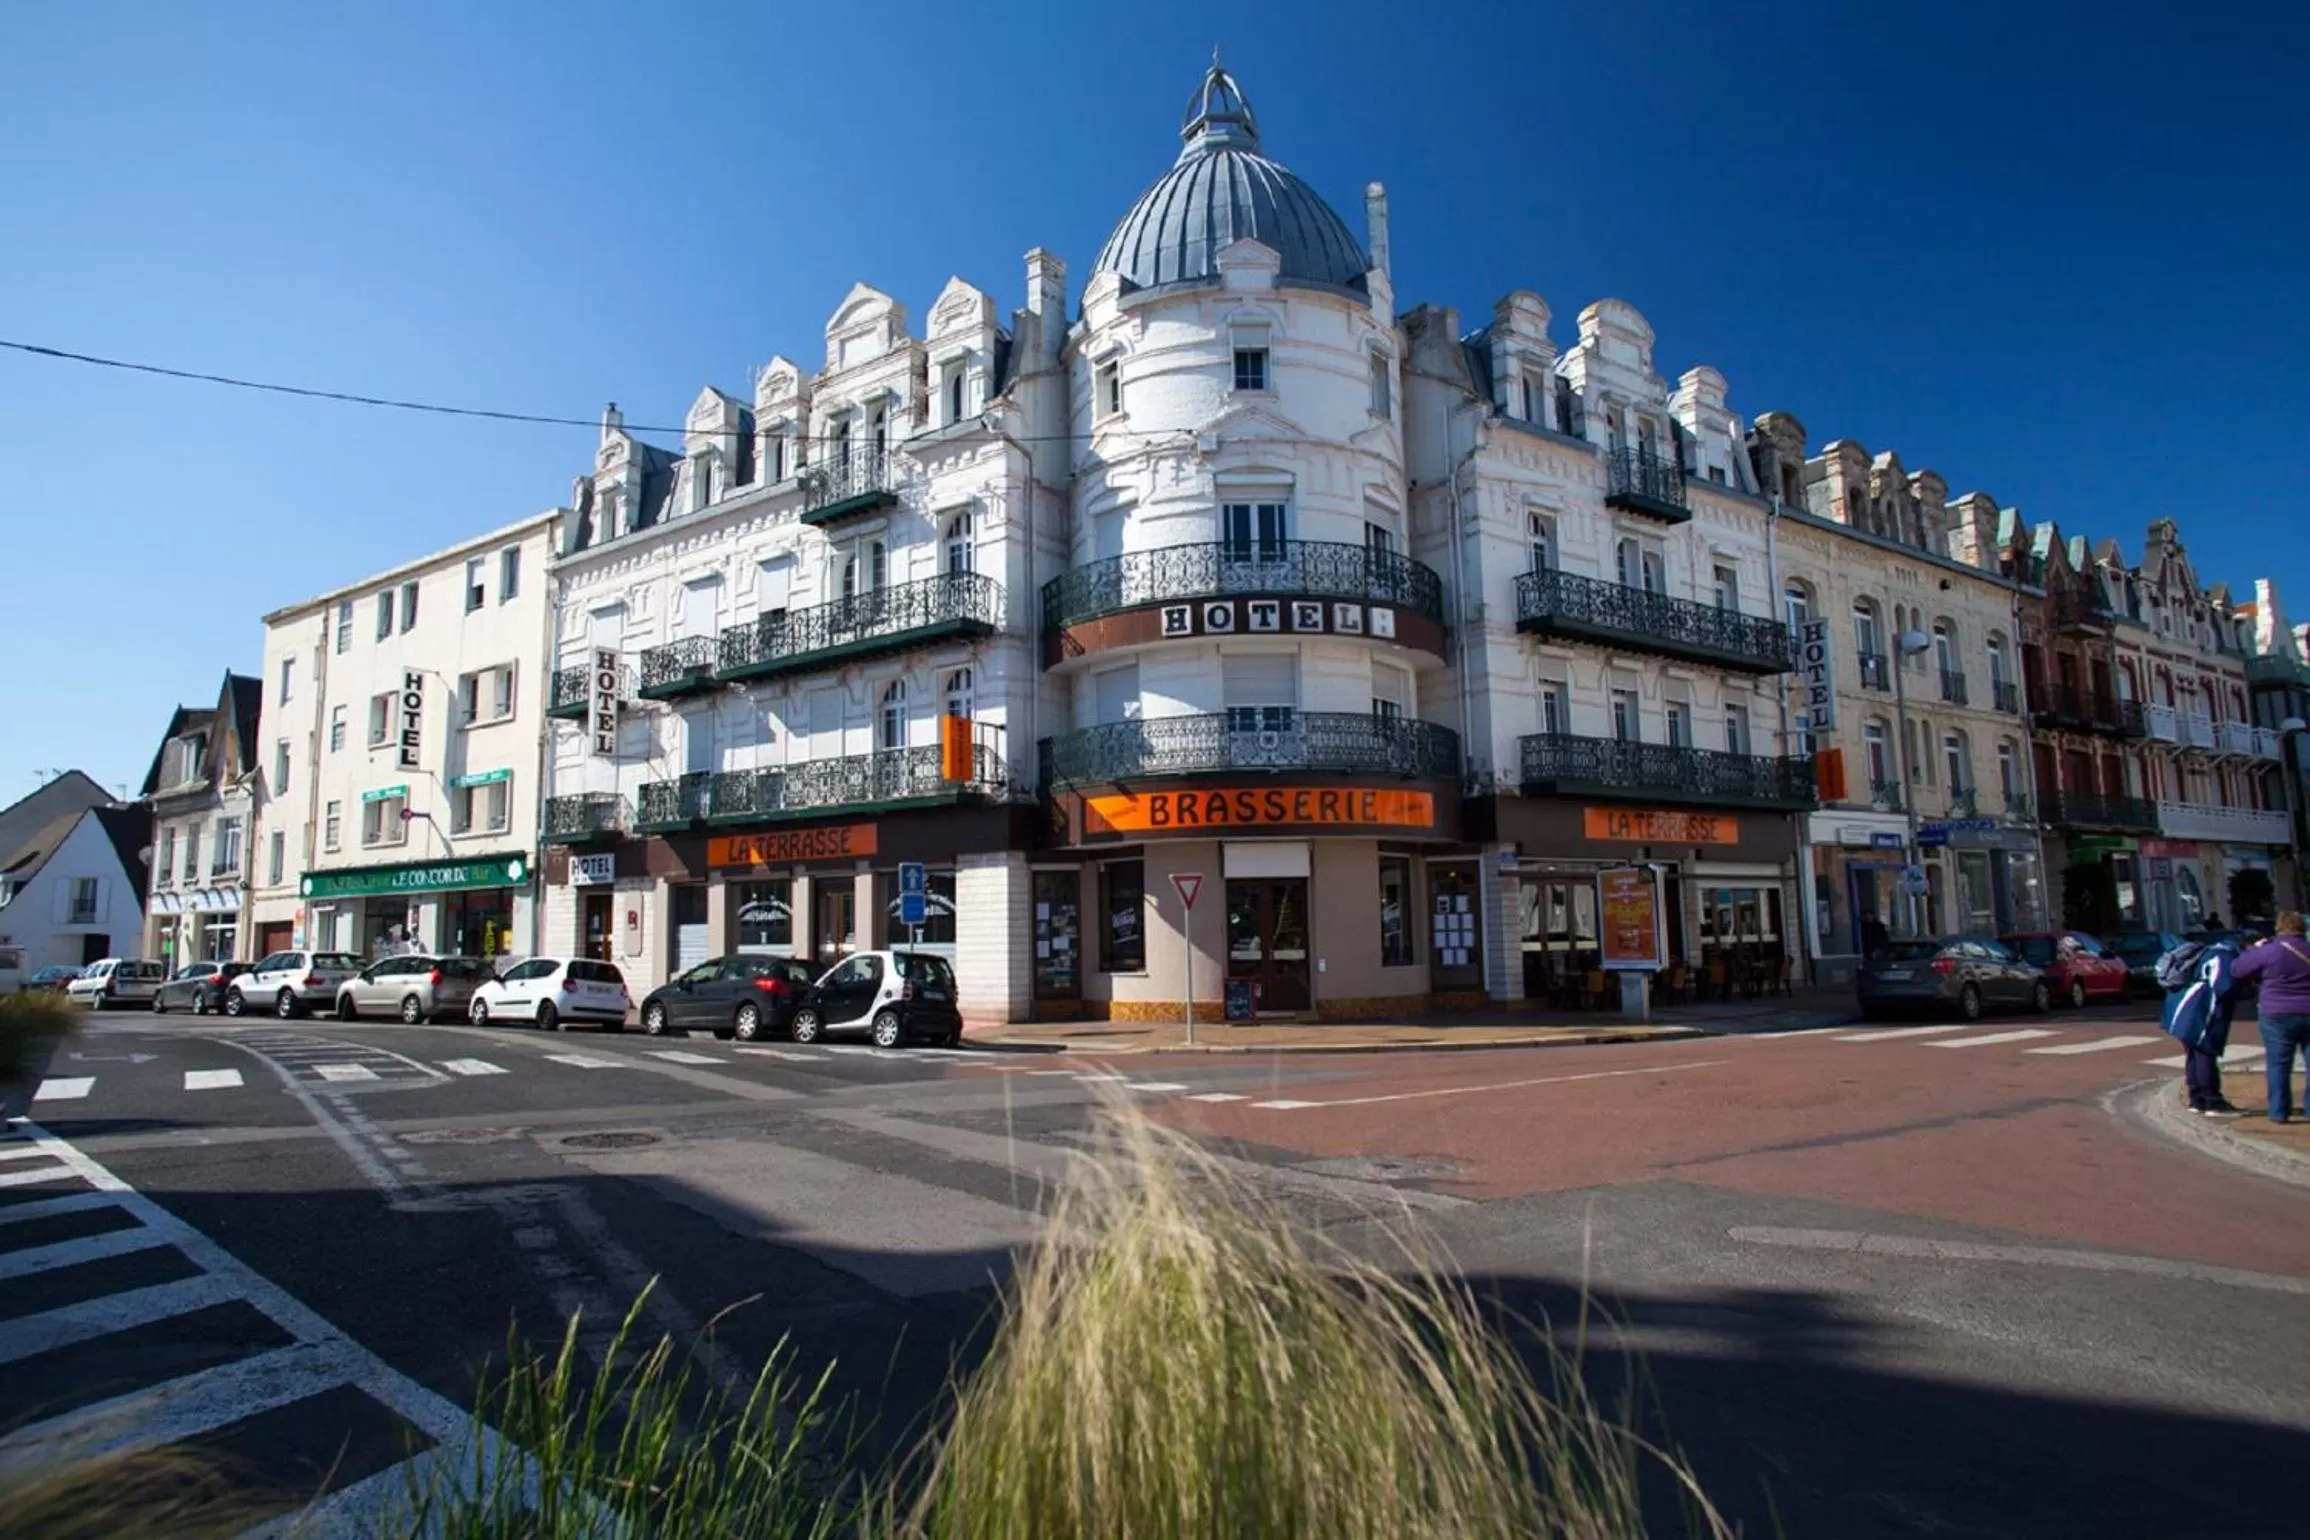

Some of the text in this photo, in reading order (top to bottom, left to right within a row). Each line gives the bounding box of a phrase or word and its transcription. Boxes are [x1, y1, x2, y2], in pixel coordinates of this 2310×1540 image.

[1165, 604, 1359, 633] HOTEL
[1803, 623, 1830, 727] HOTEL
[401, 672, 423, 766] HOTEL
[598, 651, 616, 754] HOTEL
[1150, 790, 1377, 826] BRASSERIE
[1608, 811, 1721, 841] LA TERRASSE
[728, 829, 851, 861] LA TERRASSE
[572, 856, 610, 876] HOTEL
